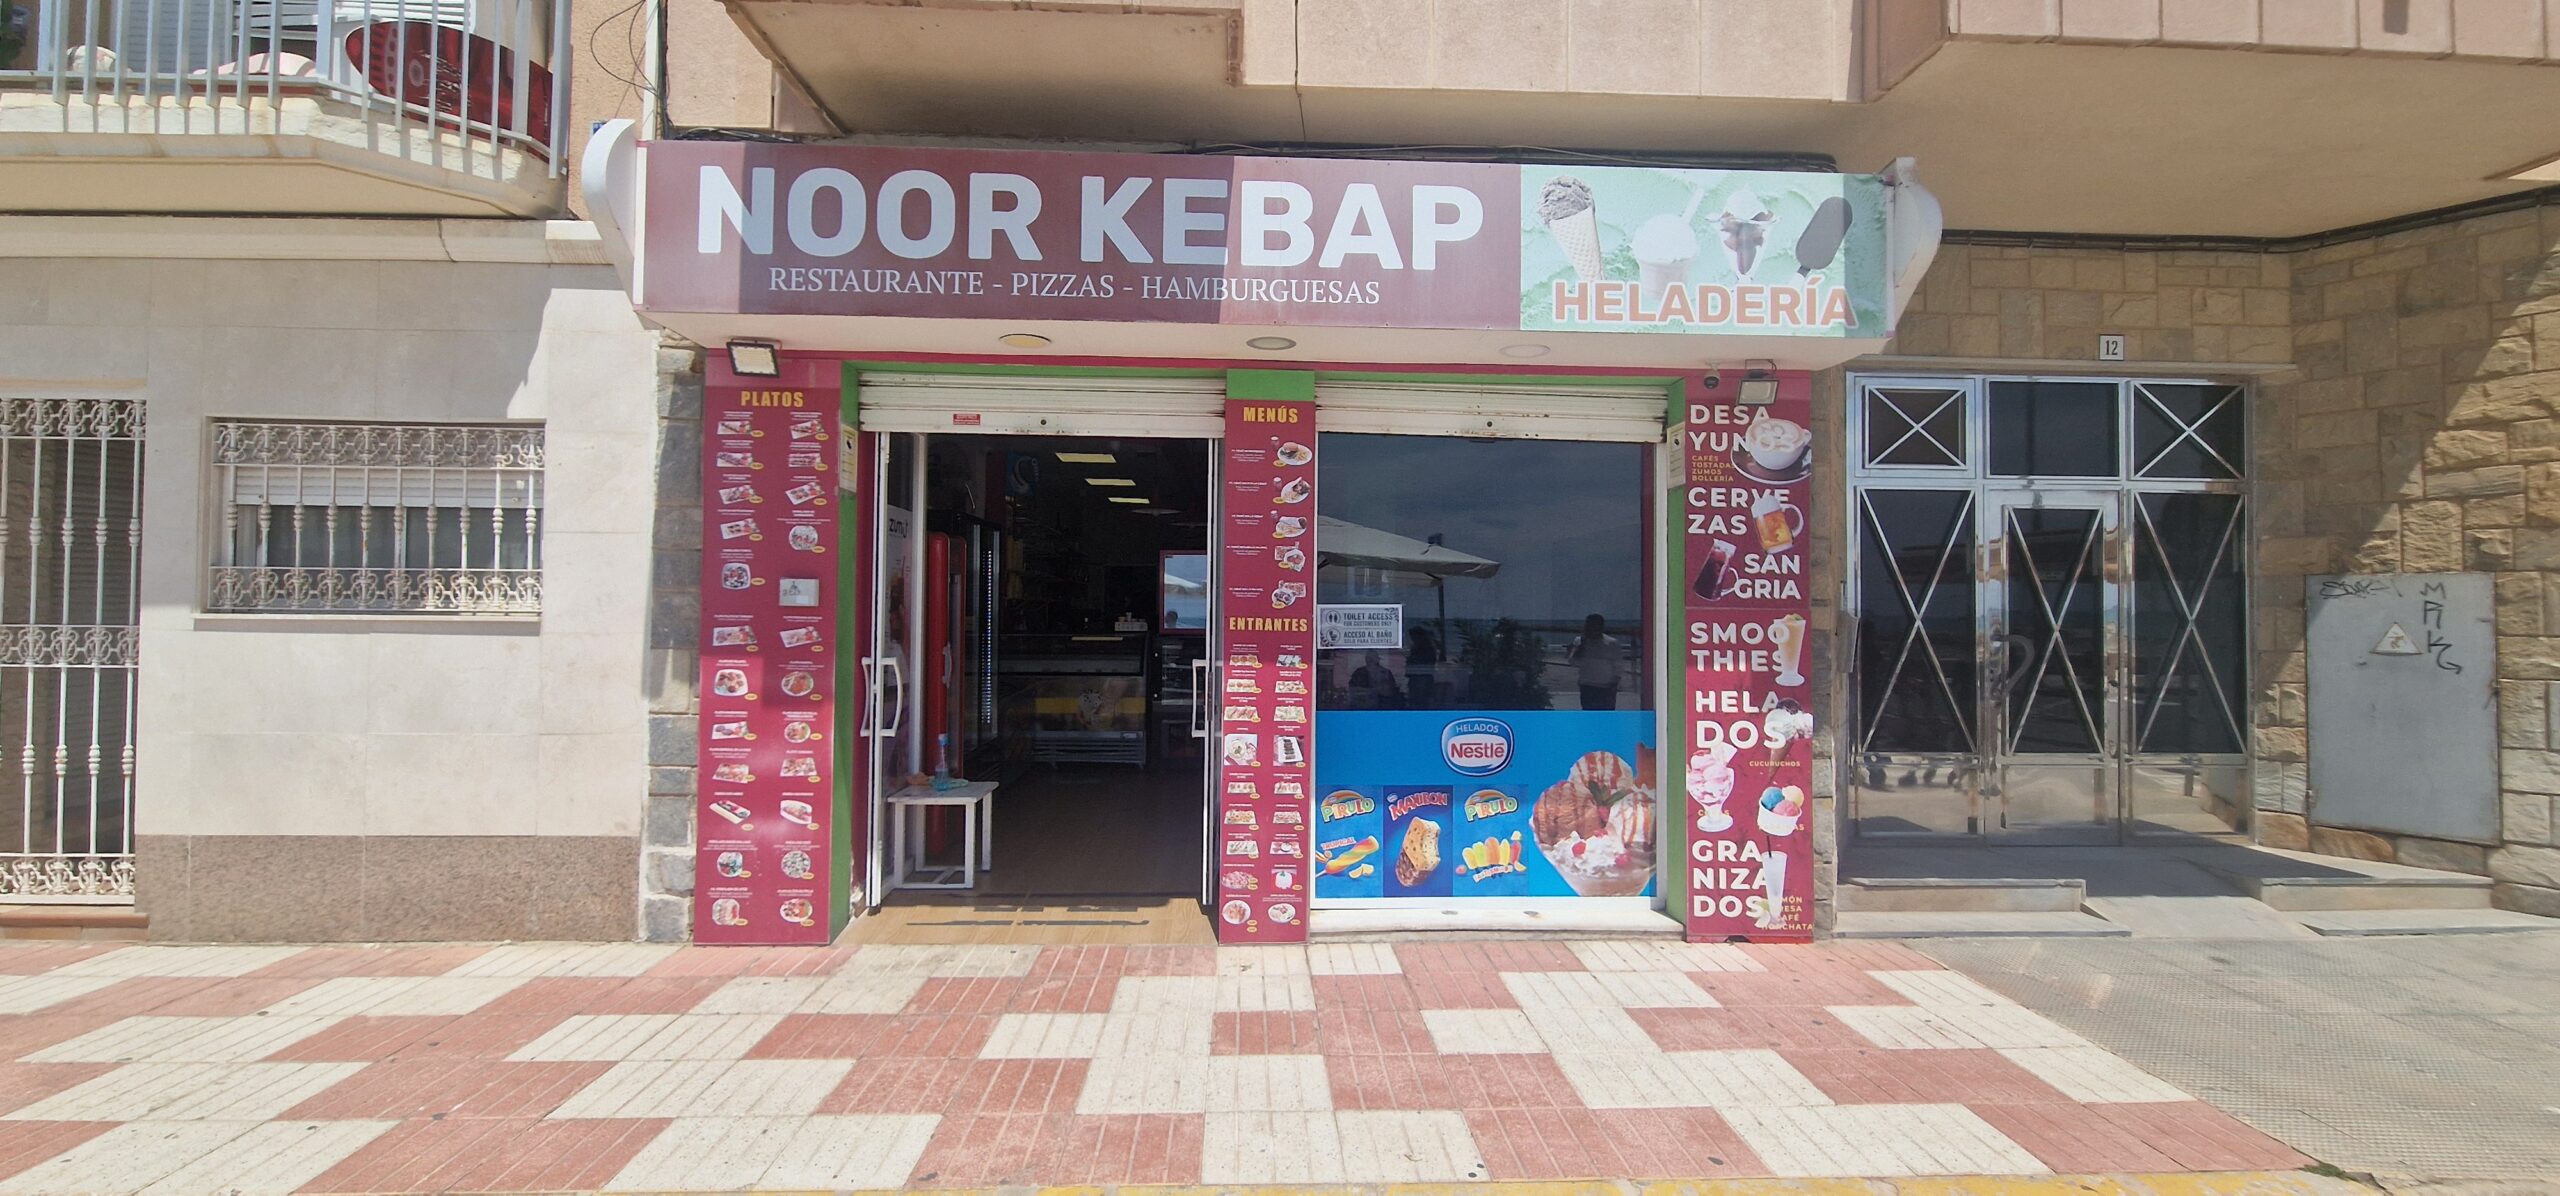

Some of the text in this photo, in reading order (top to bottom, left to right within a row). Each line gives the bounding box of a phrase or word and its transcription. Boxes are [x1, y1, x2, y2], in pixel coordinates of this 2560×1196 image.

[698, 165, 1484, 271] NOOR KEBAP
[769, 266, 983, 297] RESTAURANTE
[1011, 273, 1114, 299] PIZZAS
[1141, 276, 1380, 304] HAMBURGUESAS
[1554, 276, 1858, 328] HELADERÍA
[2105, 340, 2118, 356] 12
[740, 391, 804, 408] PLATOS
[1243, 405, 1298, 424] MENÚS
[1690, 404, 1770, 425] DESA
[1692, 474, 1734, 482] BOLLERÍA
[1688, 514, 1747, 535] ZAS
[1744, 553, 1800, 574] SAN
[1734, 578, 1801, 600] GRIA
[1229, 617, 1308, 632] ENTRANTES
[1377, 630, 1392, 638] BAÑO
[1690, 622, 1790, 645] SMOO
[1691, 650, 1783, 672] THIES
[1696, 691, 1779, 713] HELA
[1456, 724, 1499, 733] HELADOS
[1696, 720, 1787, 749] DOS
[1320, 798, 1375, 822] PIRULO
[1389, 792, 1448, 821] MAXIBON
[1464, 797, 1517, 822] PIRULO
[1692, 840, 1763, 862] GRA
[1693, 868, 1768, 890] NIZA
[1693, 895, 1764, 918] DOS
